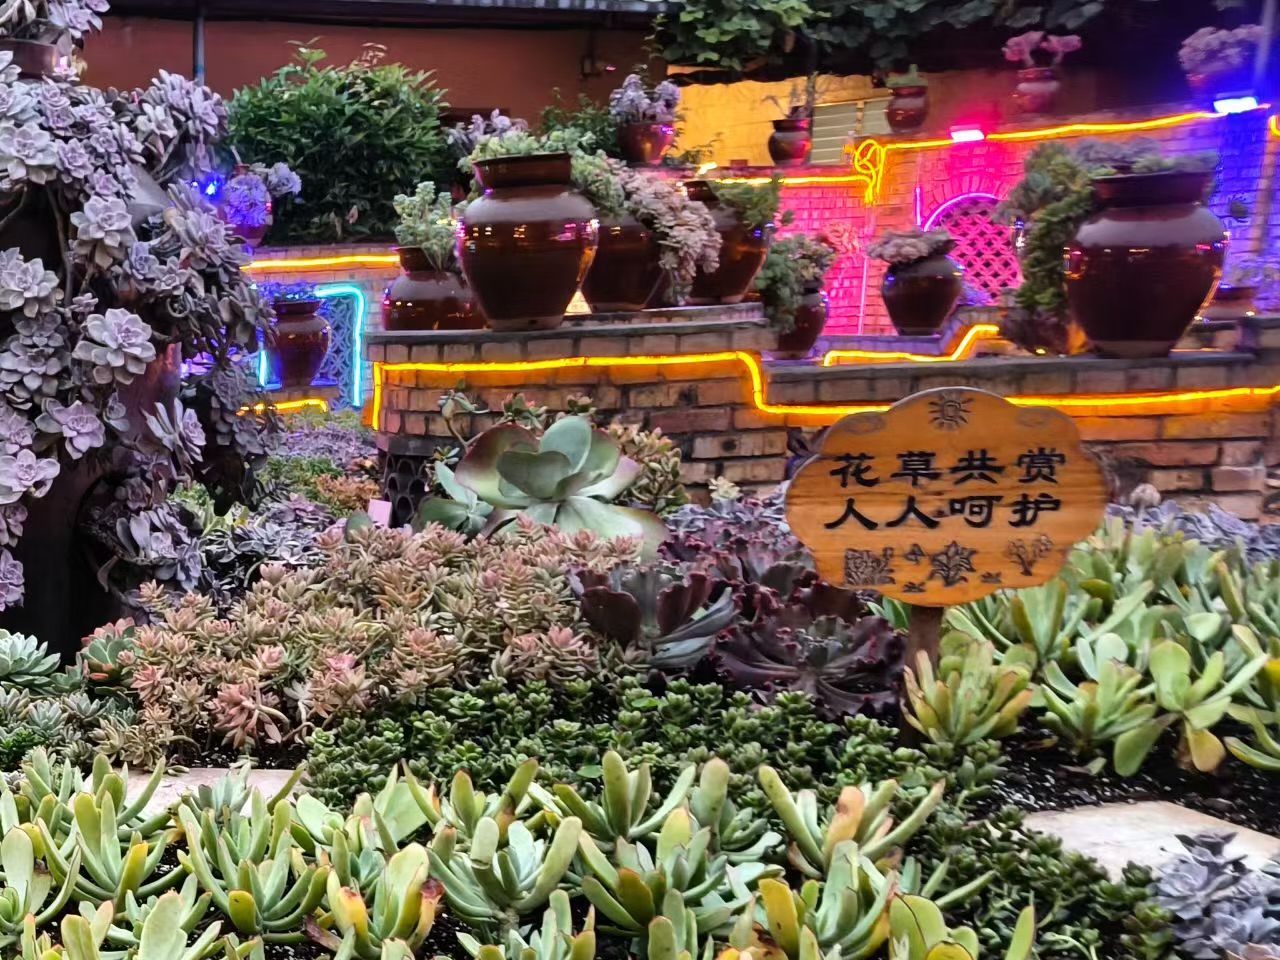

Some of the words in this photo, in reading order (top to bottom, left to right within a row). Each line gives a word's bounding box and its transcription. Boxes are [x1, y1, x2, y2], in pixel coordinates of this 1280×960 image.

[829, 447, 1066, 489] 花草共赏
[823, 492, 1064, 531] 人人呵护
